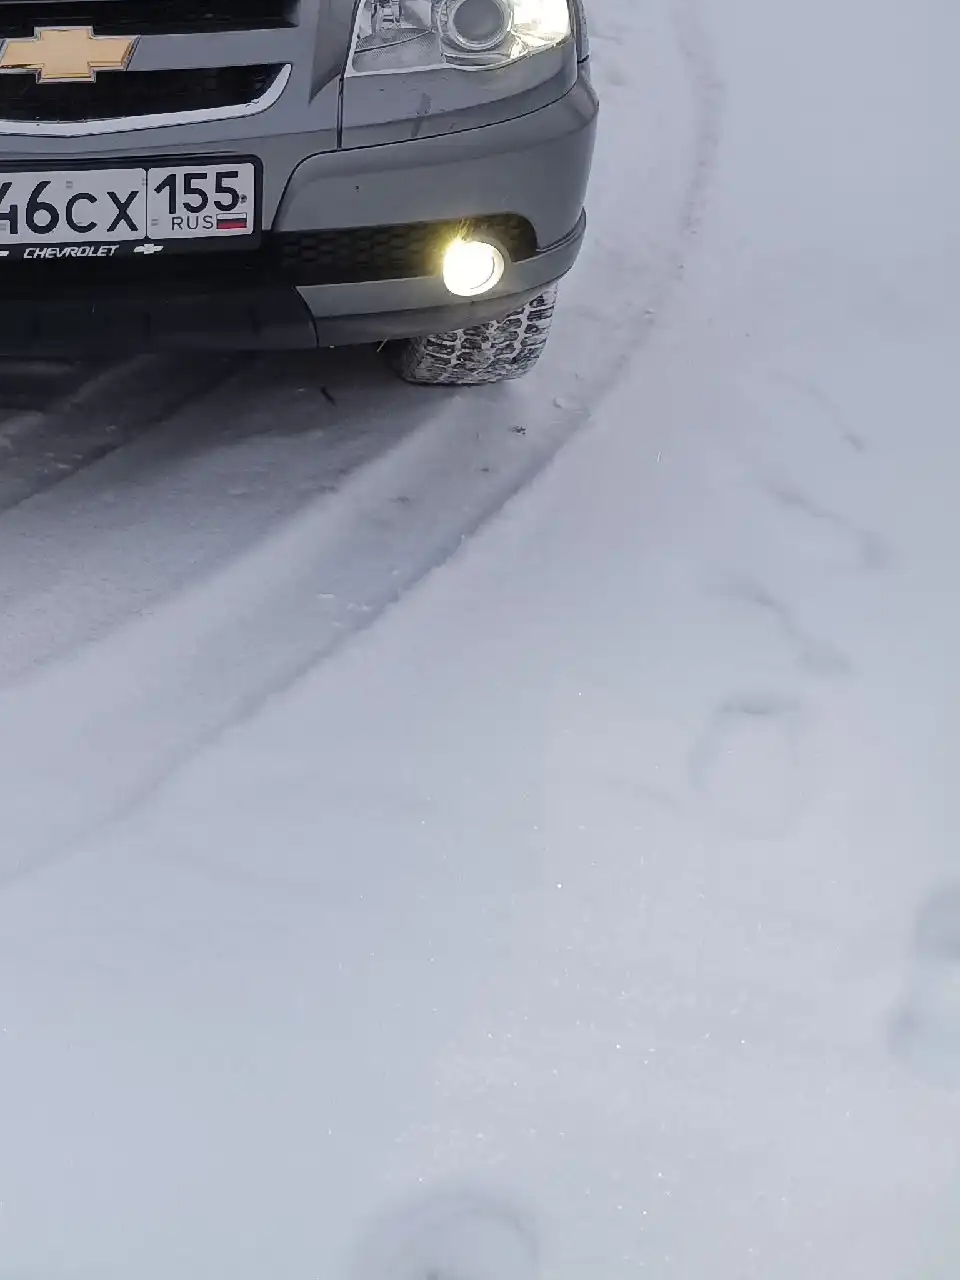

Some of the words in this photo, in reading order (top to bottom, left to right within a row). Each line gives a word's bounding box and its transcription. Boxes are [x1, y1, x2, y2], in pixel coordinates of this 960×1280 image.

[153, 170, 241, 215] 155
[170, 216, 215, 232] RUS
[23, 244, 120, 260] CHEVROLET
